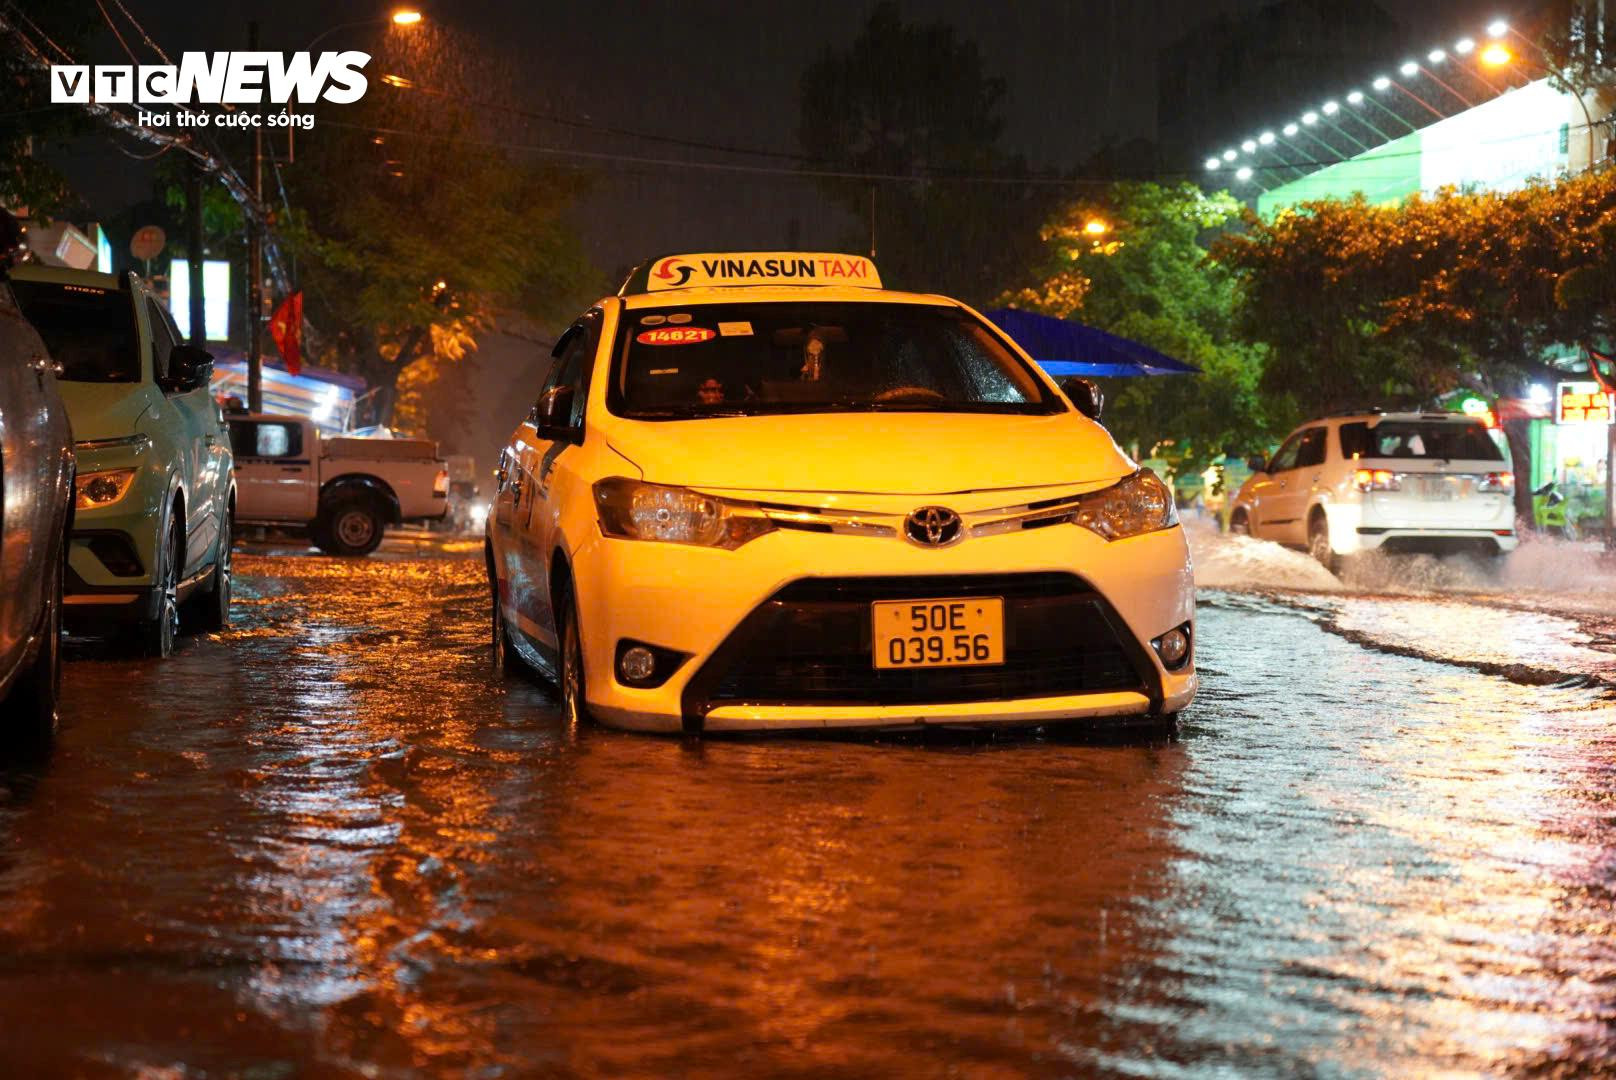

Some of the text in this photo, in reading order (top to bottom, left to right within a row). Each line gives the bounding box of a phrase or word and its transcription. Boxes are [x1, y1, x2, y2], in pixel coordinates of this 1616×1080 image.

[701, 259, 867, 279] VINASUN TAXI
[647, 329, 708, 342] 14621
[911, 603, 966, 632] 50E
[889, 633, 990, 665] 039.56
